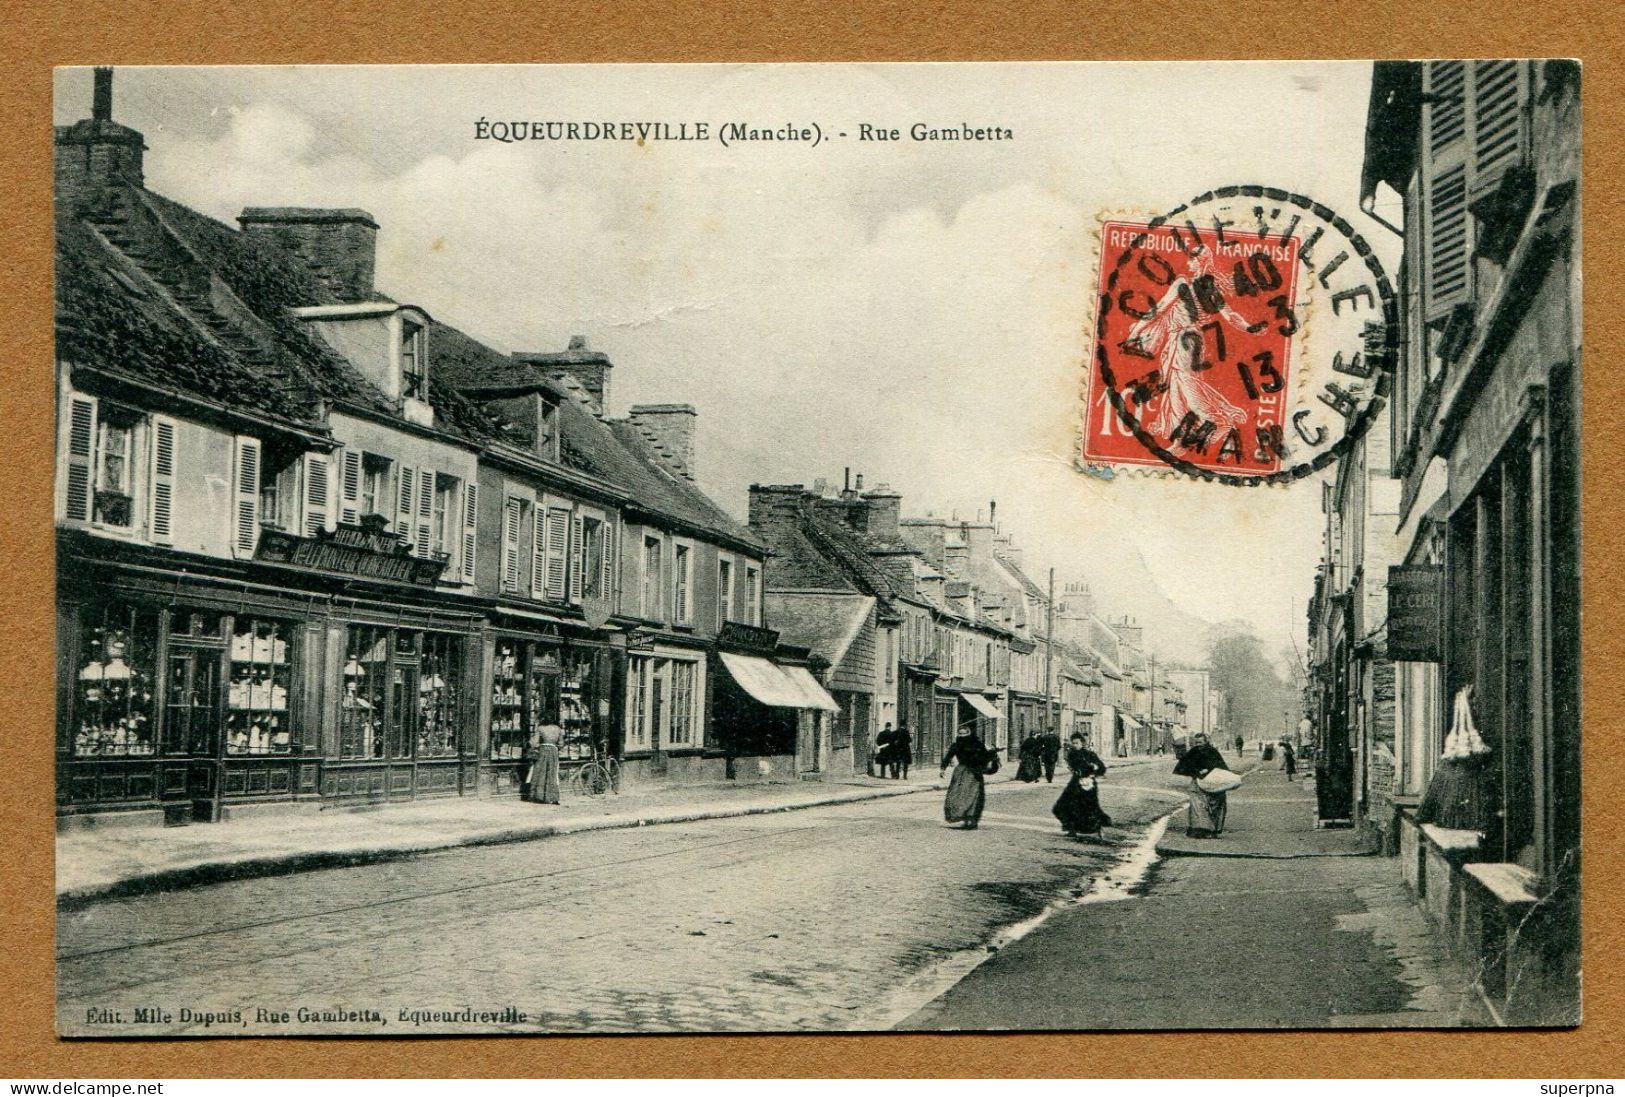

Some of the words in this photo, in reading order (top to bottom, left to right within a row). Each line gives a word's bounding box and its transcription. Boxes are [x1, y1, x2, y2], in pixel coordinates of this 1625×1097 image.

[474, 117, 709, 142] ÉQUEURDREVILLE
[718, 122, 829, 147] (Manche).
[859, 124, 900, 141] Rue
[910, 122, 1013, 141] Gambetta
[134, 1007, 172, 1024] Mlle
[179, 1007, 247, 1027] Dupuis,
[256, 1008, 290, 1023] Rue
[297, 1007, 387, 1026] Gambetta,
